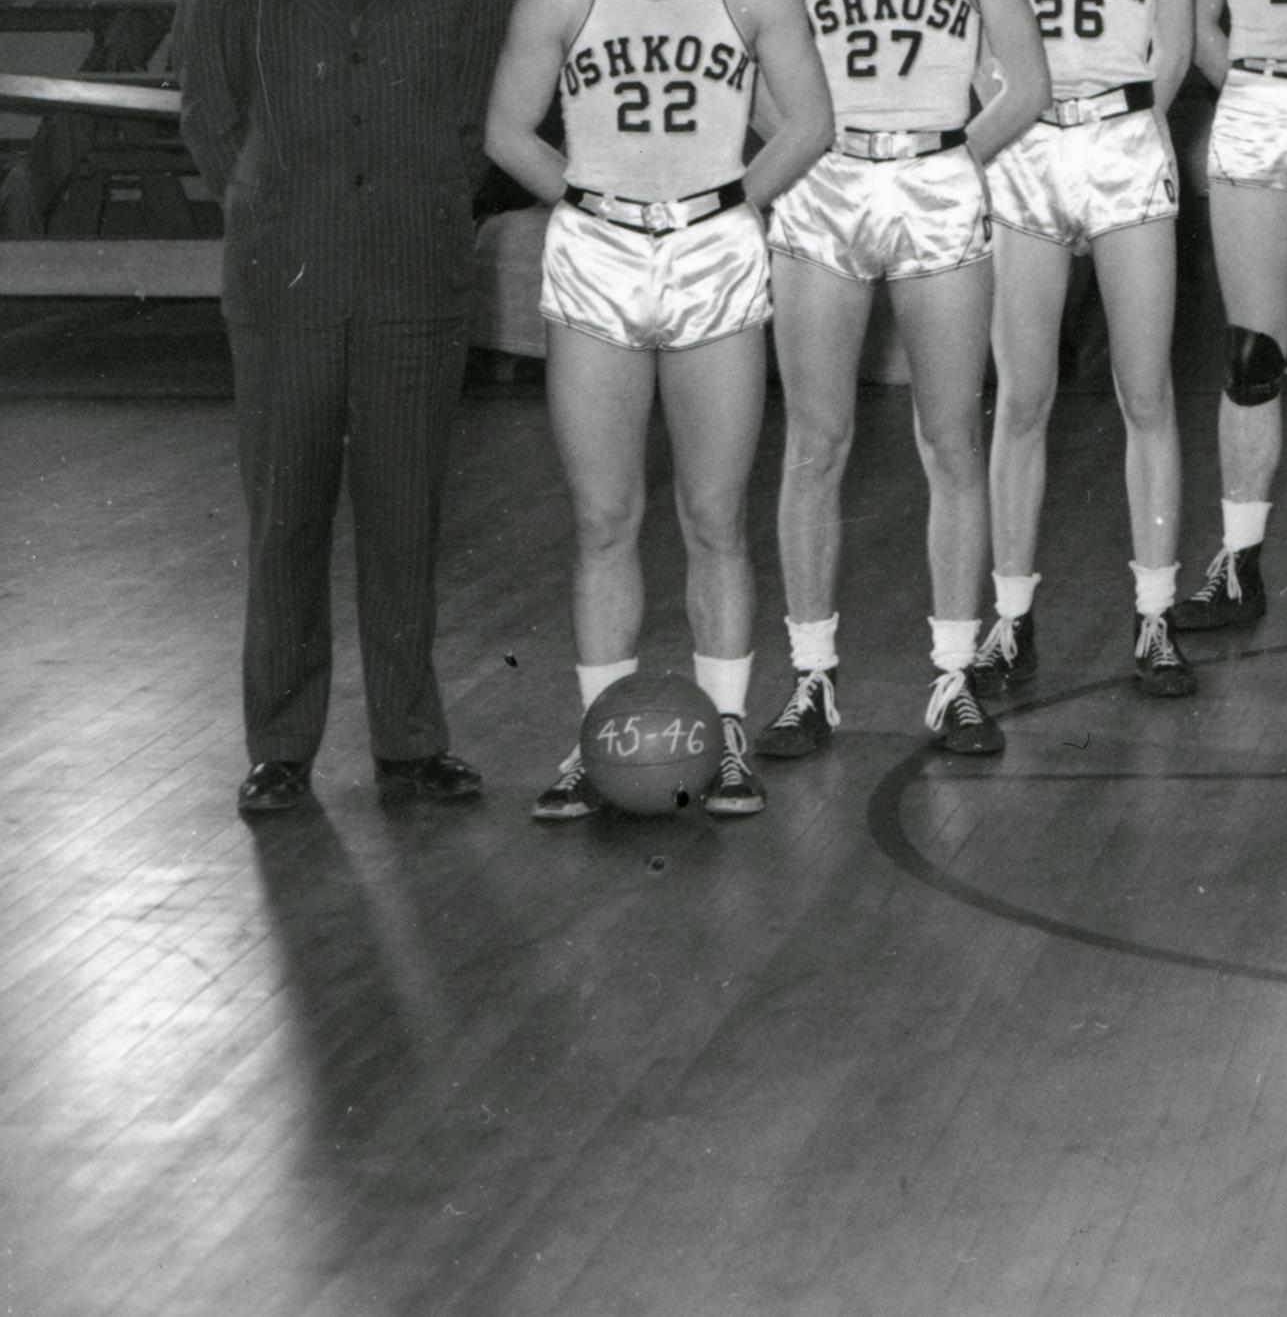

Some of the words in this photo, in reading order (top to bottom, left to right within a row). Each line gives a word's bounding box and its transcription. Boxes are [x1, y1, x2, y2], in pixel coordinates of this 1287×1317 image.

[564, 35, 750, 96] OSHKOSH
[846, 29, 923, 78] 27
[613, 80, 697, 133] 22
[597, 716, 706, 757] 45-46
